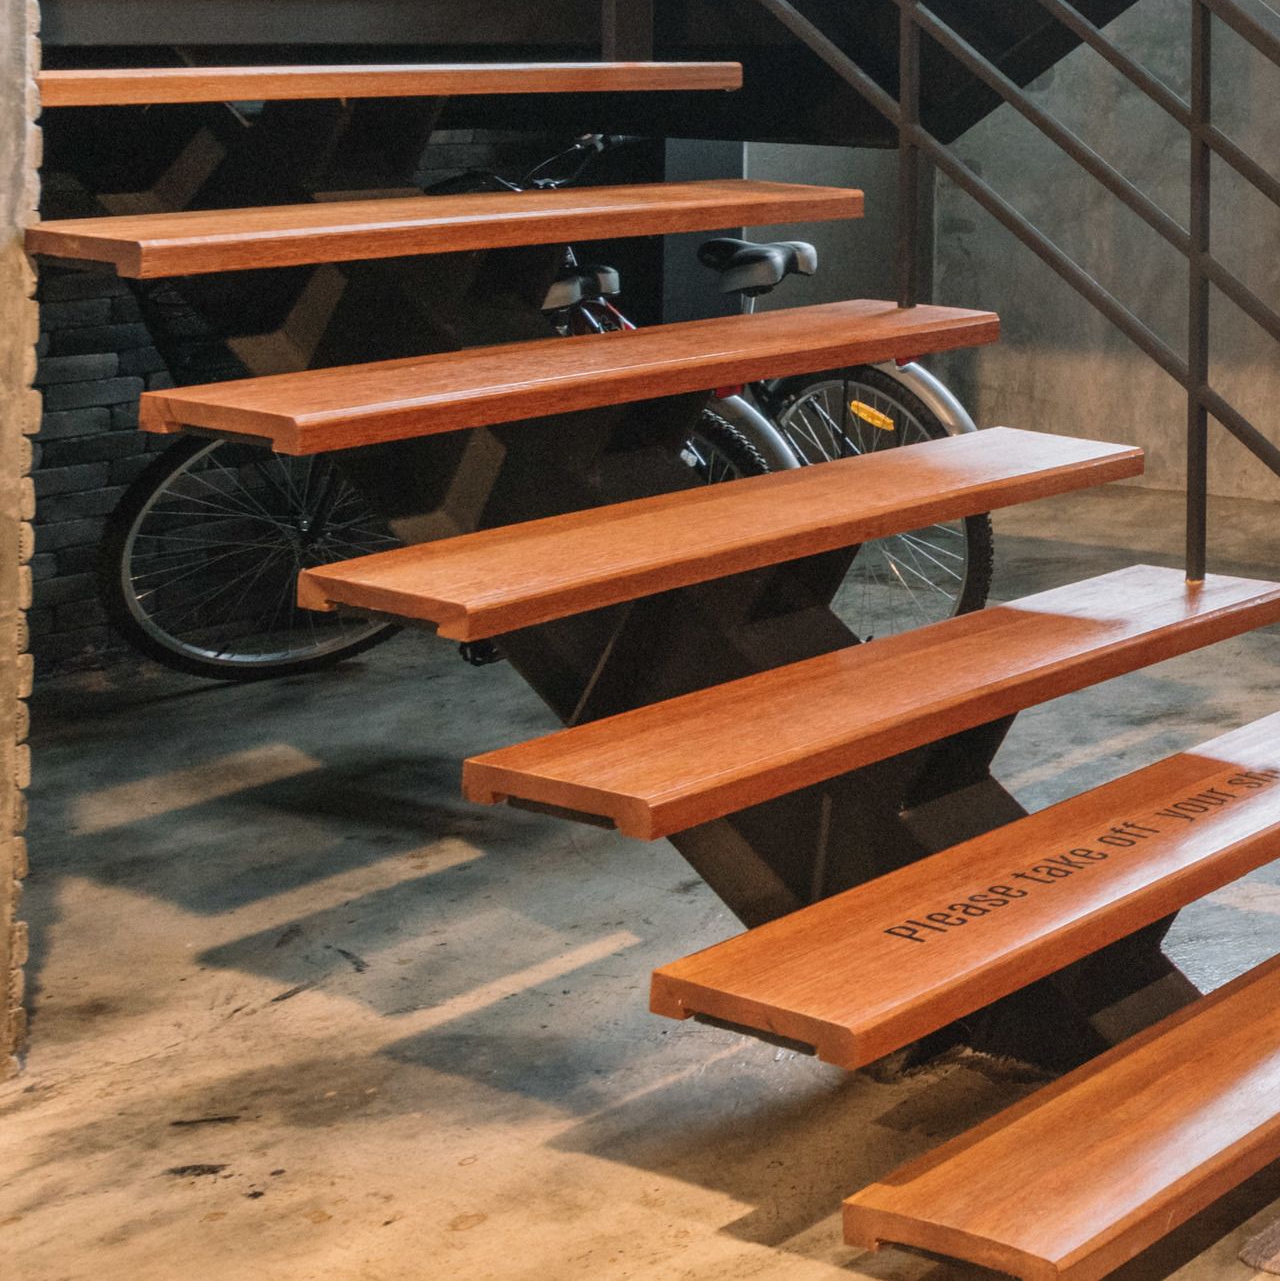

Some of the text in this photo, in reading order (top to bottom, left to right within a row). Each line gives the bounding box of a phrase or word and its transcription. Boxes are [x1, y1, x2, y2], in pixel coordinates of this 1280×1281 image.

[884, 883, 1028, 943] Please
[1015, 845, 1108, 885] take
[1097, 820, 1161, 849] off
[1155, 786, 1237, 823] your
